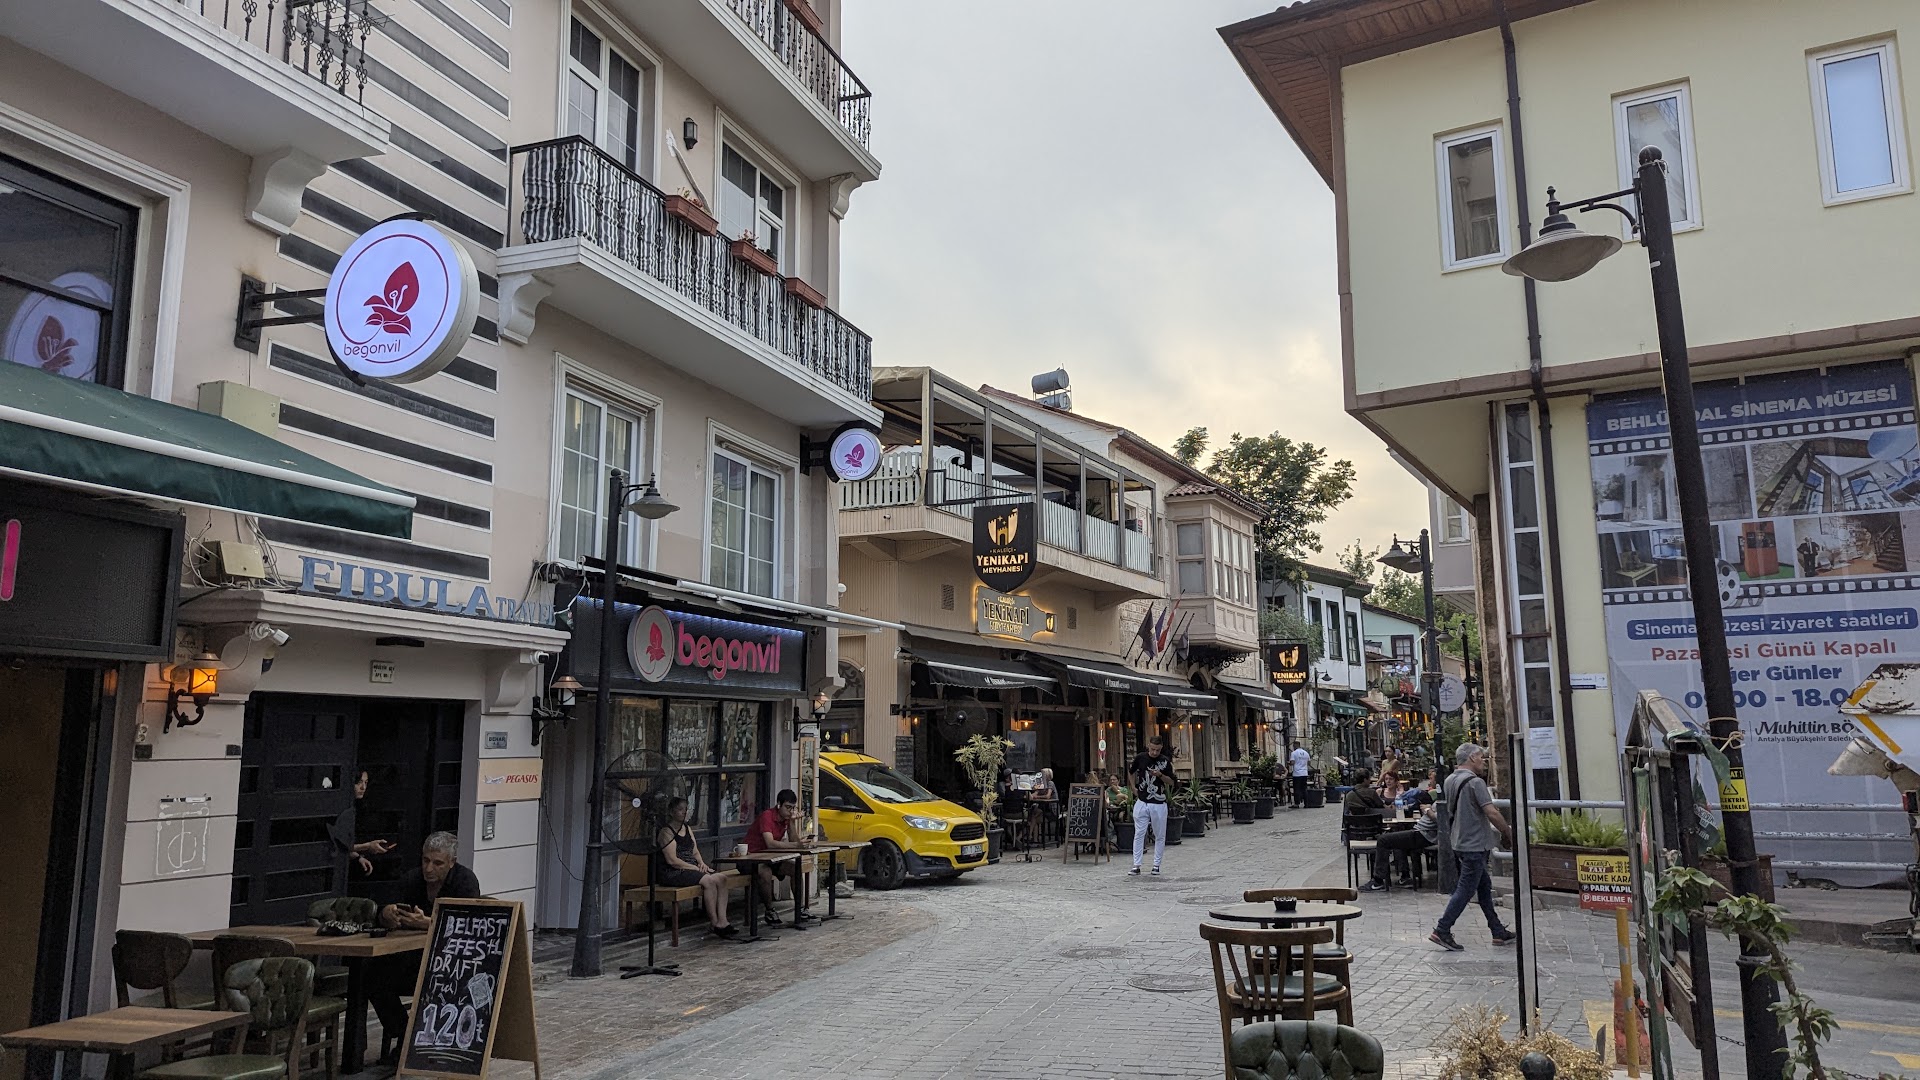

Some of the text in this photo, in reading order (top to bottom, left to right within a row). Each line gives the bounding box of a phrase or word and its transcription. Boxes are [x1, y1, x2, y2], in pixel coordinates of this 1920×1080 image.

[343, 339, 401, 359] begonvil
[1606, 410, 1669, 431] BEHLÜ
[1731, 400, 1812, 418] SİNEMA
[1817, 384, 1898, 408] MÜZESİ
[976, 552, 1029, 566] YENİKAPI
[298, 555, 498, 618] FIBULA
[1635, 620, 1697, 636] Sinema
[1771, 615, 1833, 631] ziyaret
[1839, 611, 1909, 628] saatleri
[678, 621, 781, 680] begonvil
[1758, 641, 1815, 658] Günü
[1824, 638, 1897, 657] Kapalı
[1766, 665, 1843, 681] Günler
[1791, 687, 1849, 707] 18.0
[1755, 721, 1829, 735] Muhittin
[1757, 736, 1785, 744] Antalya
[1787, 735, 1826, 744] Büyükşehir
[506, 774, 539, 784] PEGASUS
[1590, 884, 1610, 893] PARK
[1592, 894, 1625, 903] BEKLEME
[444, 915, 508, 937] BELFAST
[442, 938, 486, 961] EFES
[433, 955, 482, 980] DRAFT
